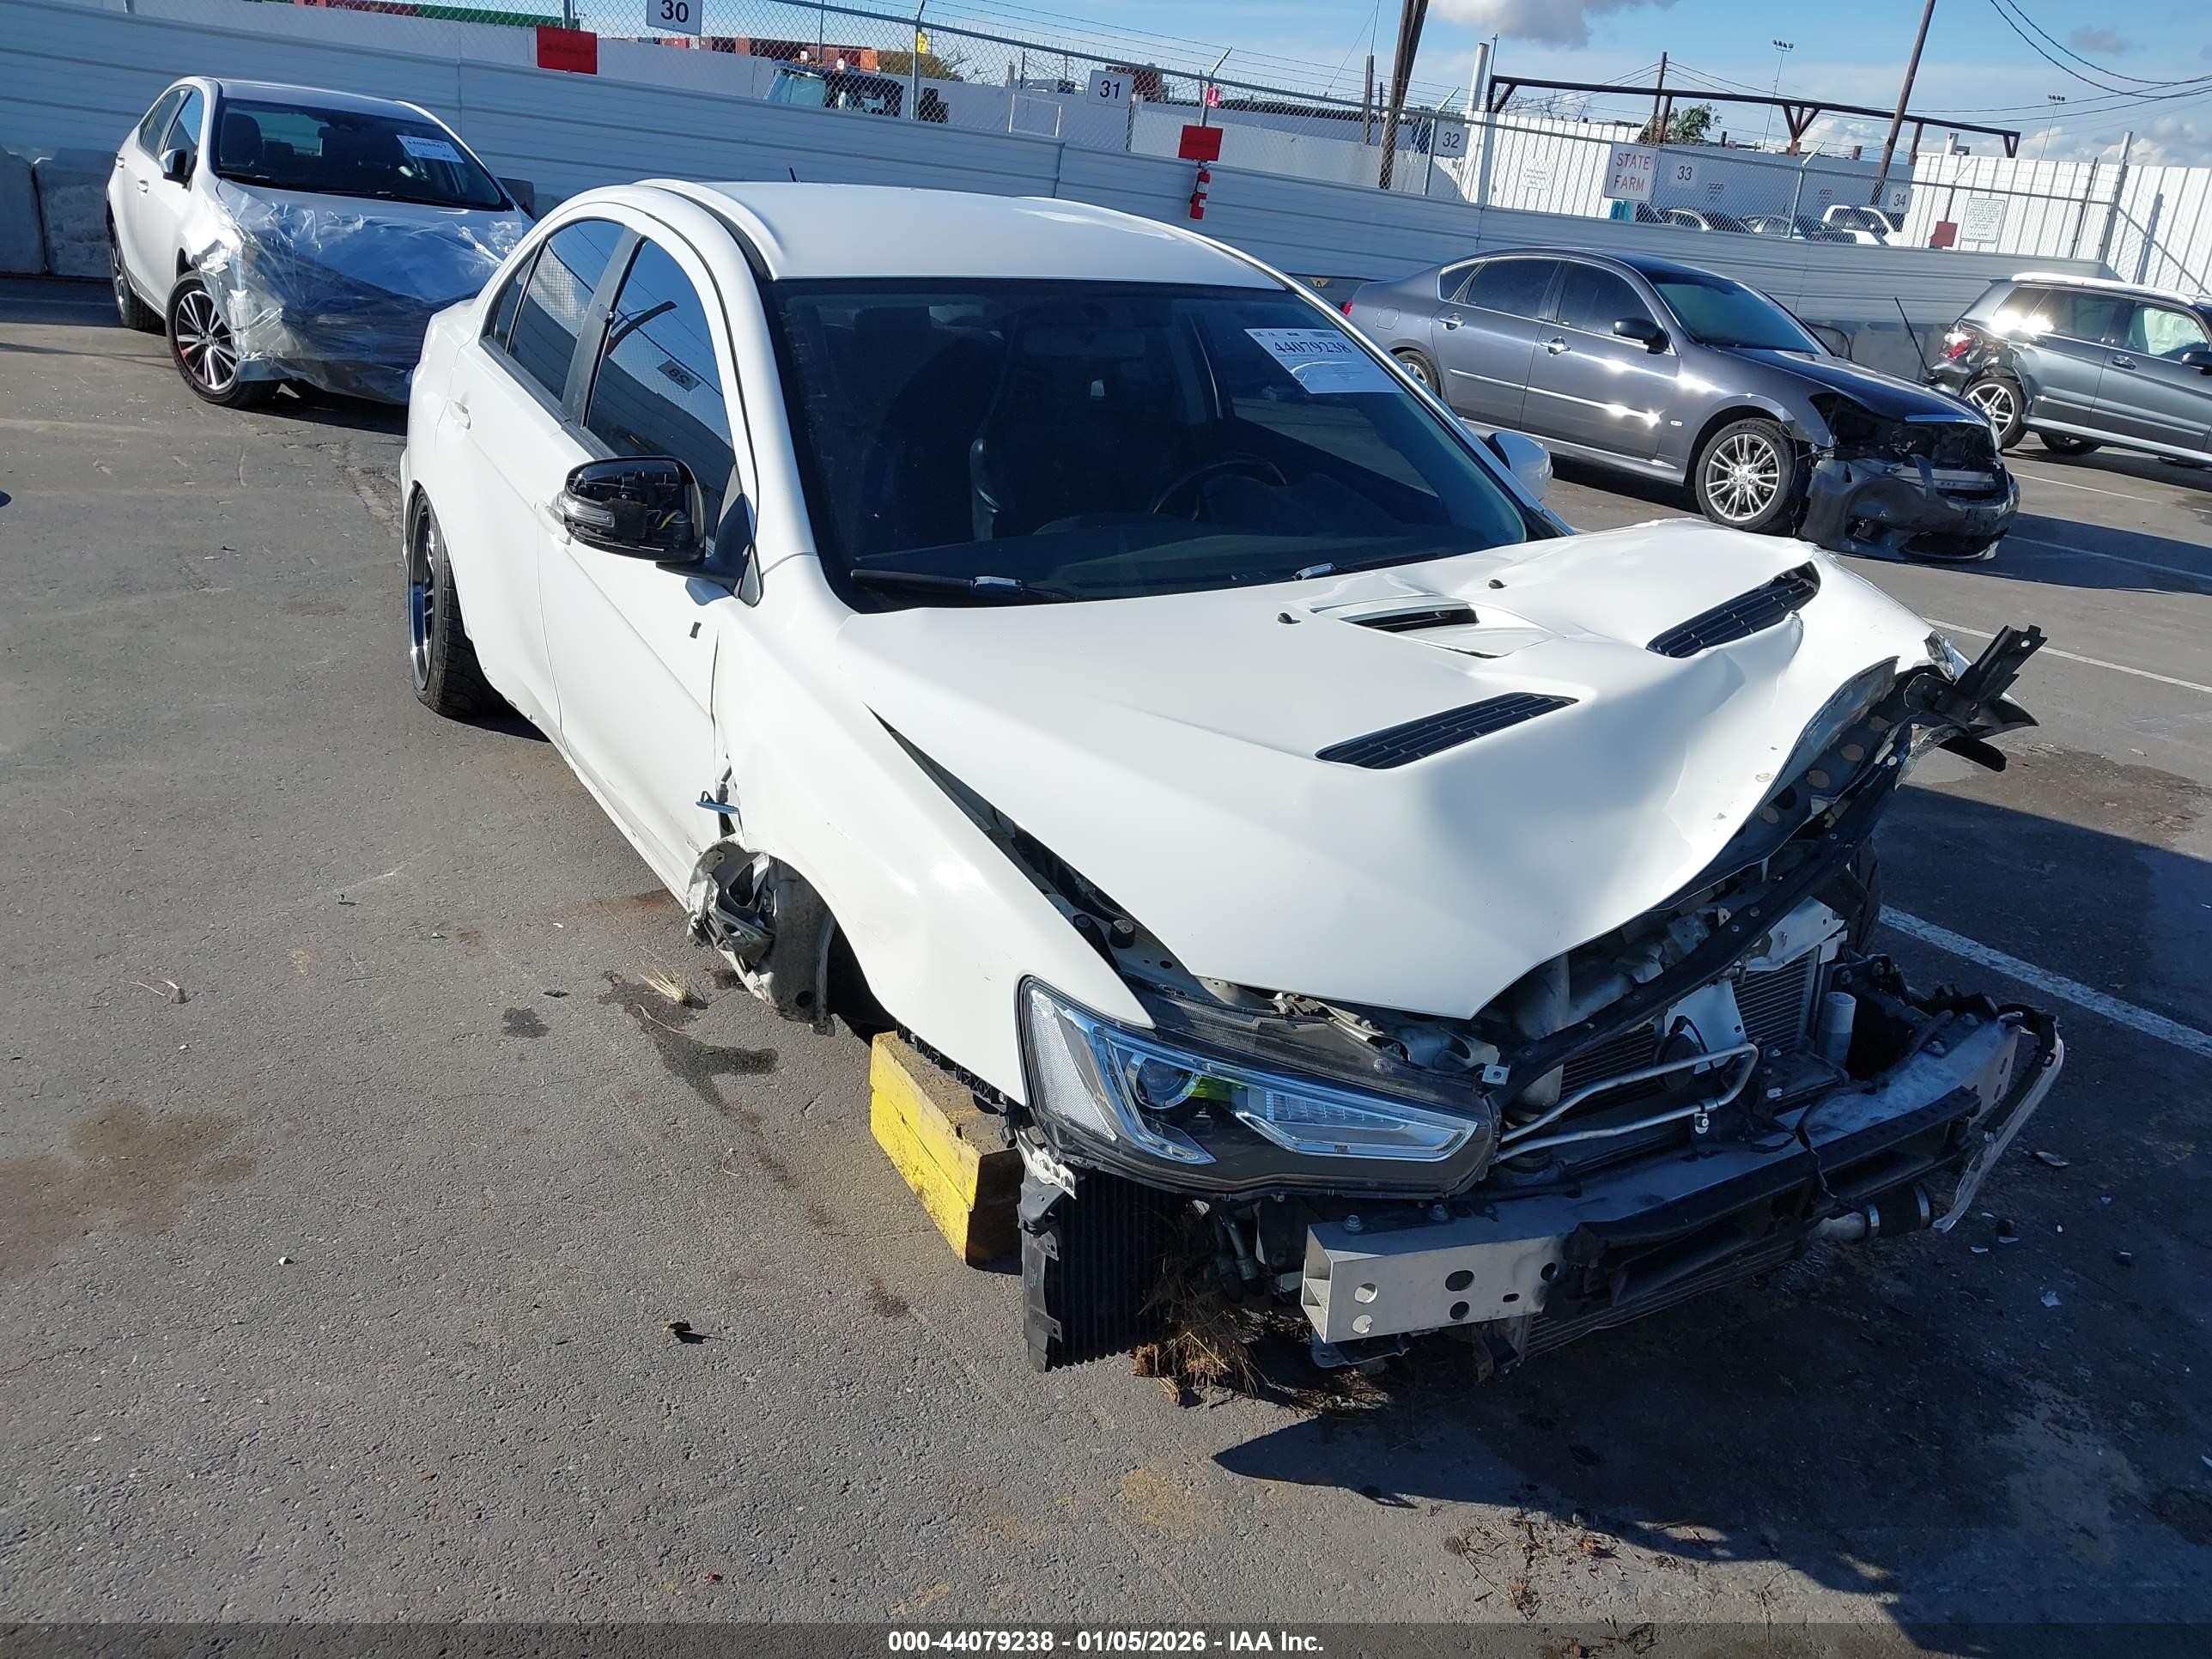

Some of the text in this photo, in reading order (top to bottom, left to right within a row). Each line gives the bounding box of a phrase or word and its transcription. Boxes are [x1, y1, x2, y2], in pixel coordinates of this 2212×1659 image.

[660, 0, 690, 23] 30
[1099, 80, 1121, 100] 31
[1442, 131, 1461, 149] 32
[1616, 153, 1651, 170] STATE
[1677, 165, 1693, 181] 33
[1613, 174, 1645, 192] FARM
[1893, 193, 1906, 207] 34
[1274, 342, 1352, 354] 44079238
